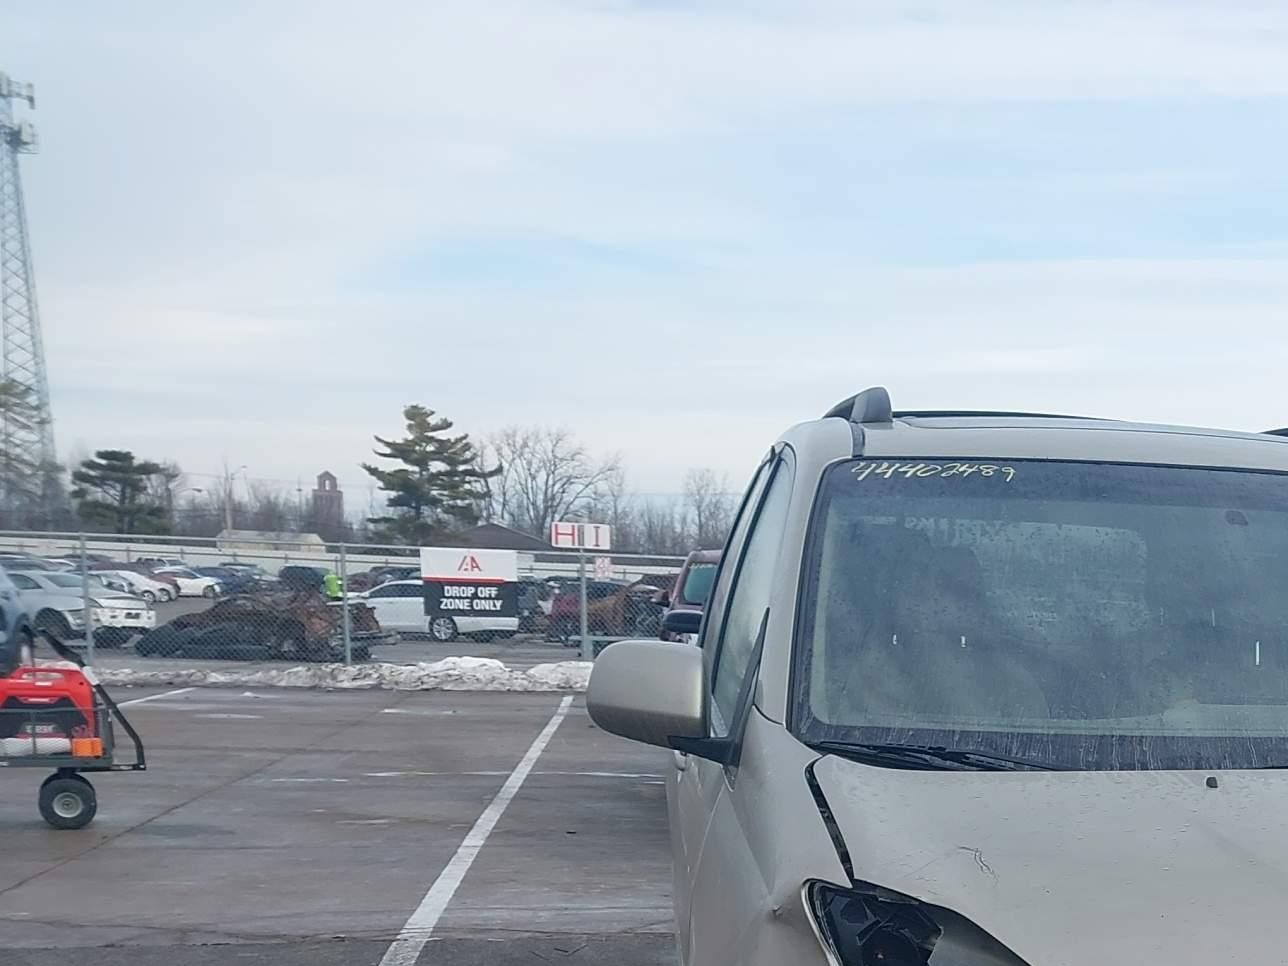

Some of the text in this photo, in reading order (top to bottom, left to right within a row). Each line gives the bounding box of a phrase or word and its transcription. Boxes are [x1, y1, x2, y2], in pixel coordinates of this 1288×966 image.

[851, 462, 1016, 482] 44402489
[443, 585, 499, 598] DROP OFF
[440, 598, 503, 611] ZONE ONLY
